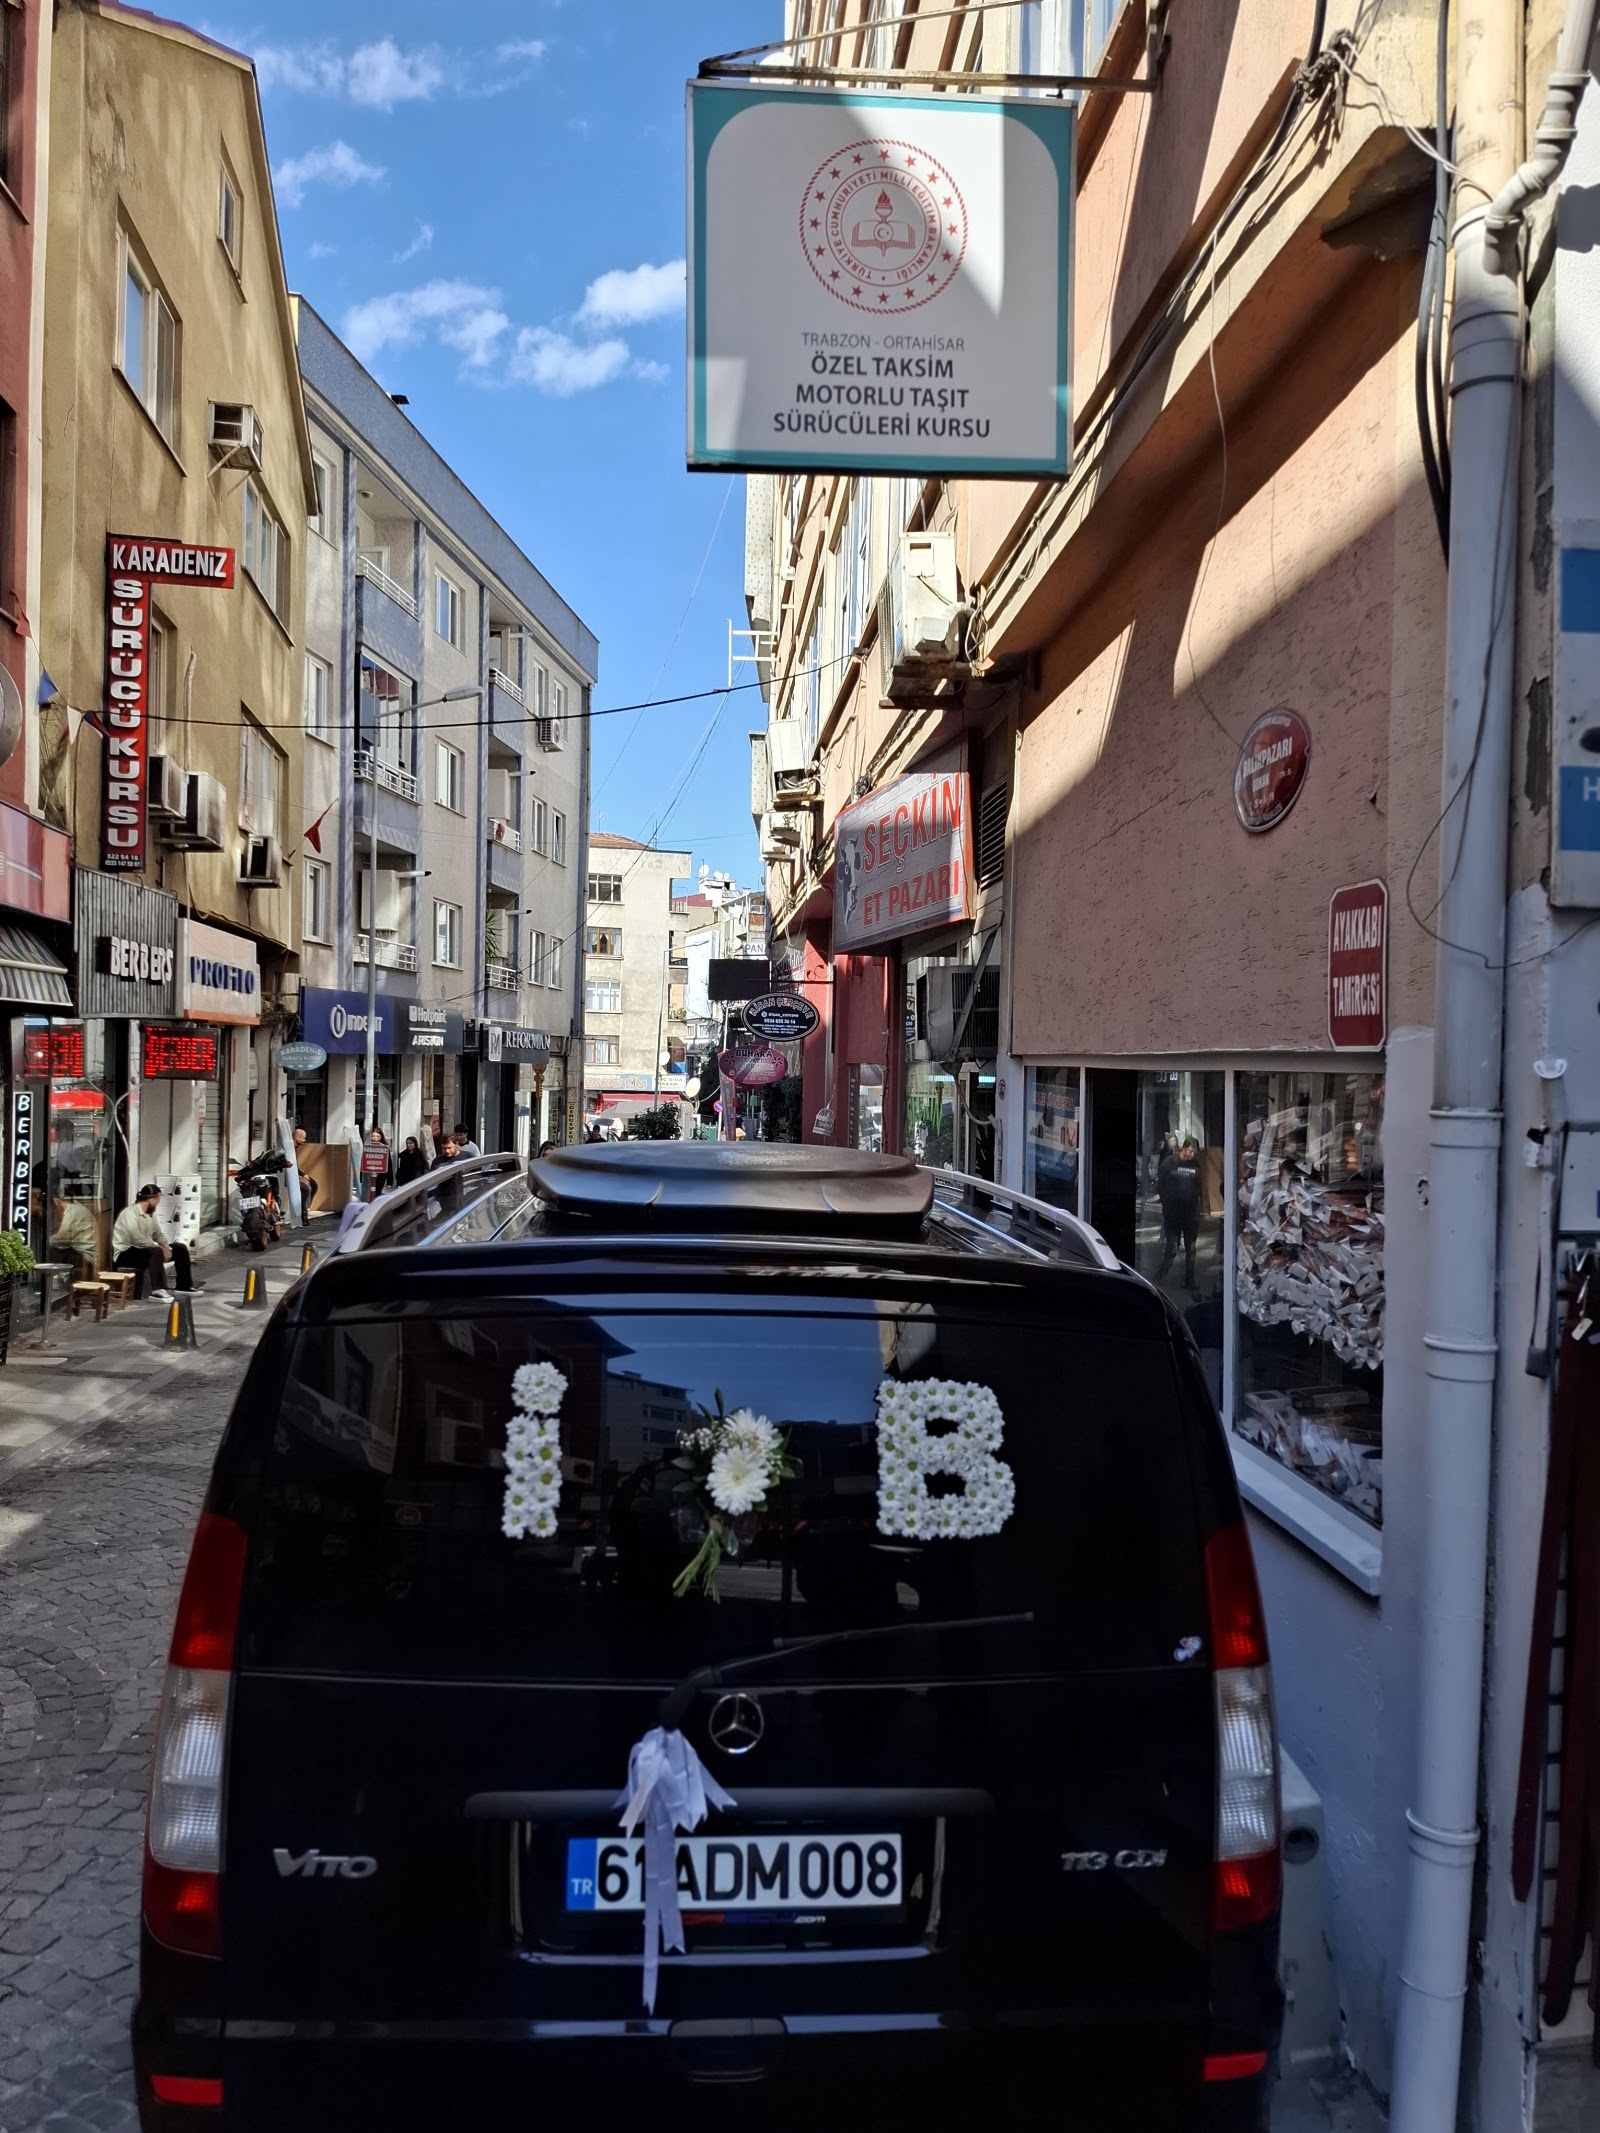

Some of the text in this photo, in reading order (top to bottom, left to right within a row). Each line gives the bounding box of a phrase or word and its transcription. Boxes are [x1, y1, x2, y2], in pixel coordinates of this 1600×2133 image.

[831, 170, 876, 236] CUMHURİYETİ
[802, 332, 871, 349] TRABZON
[883, 333, 965, 352] ORTAHİSAR
[811, 351, 954, 378] ÖZEL TAKSİM
[795, 384, 970, 413] MOTORLU TAŞIT
[773, 409, 991, 439] SÜRÜCÜLERİ KURSU
[107, 578, 144, 848] SÜRÜCÜ KURSU
[1242, 736, 1293, 779] BALIKPAZARI
[863, 770, 961, 874] SEÇKİN
[863, 857, 961, 929] ET PAZARI
[1333, 905, 1382, 953] AYAKKABI
[110, 935, 174, 986] BERBERS
[412, 1035, 444, 1046] ARISTON
[736, 1049, 773, 1058] BUHARA
[876, 1376, 1016, 1540] B
[571, 1878, 593, 1895] TR
